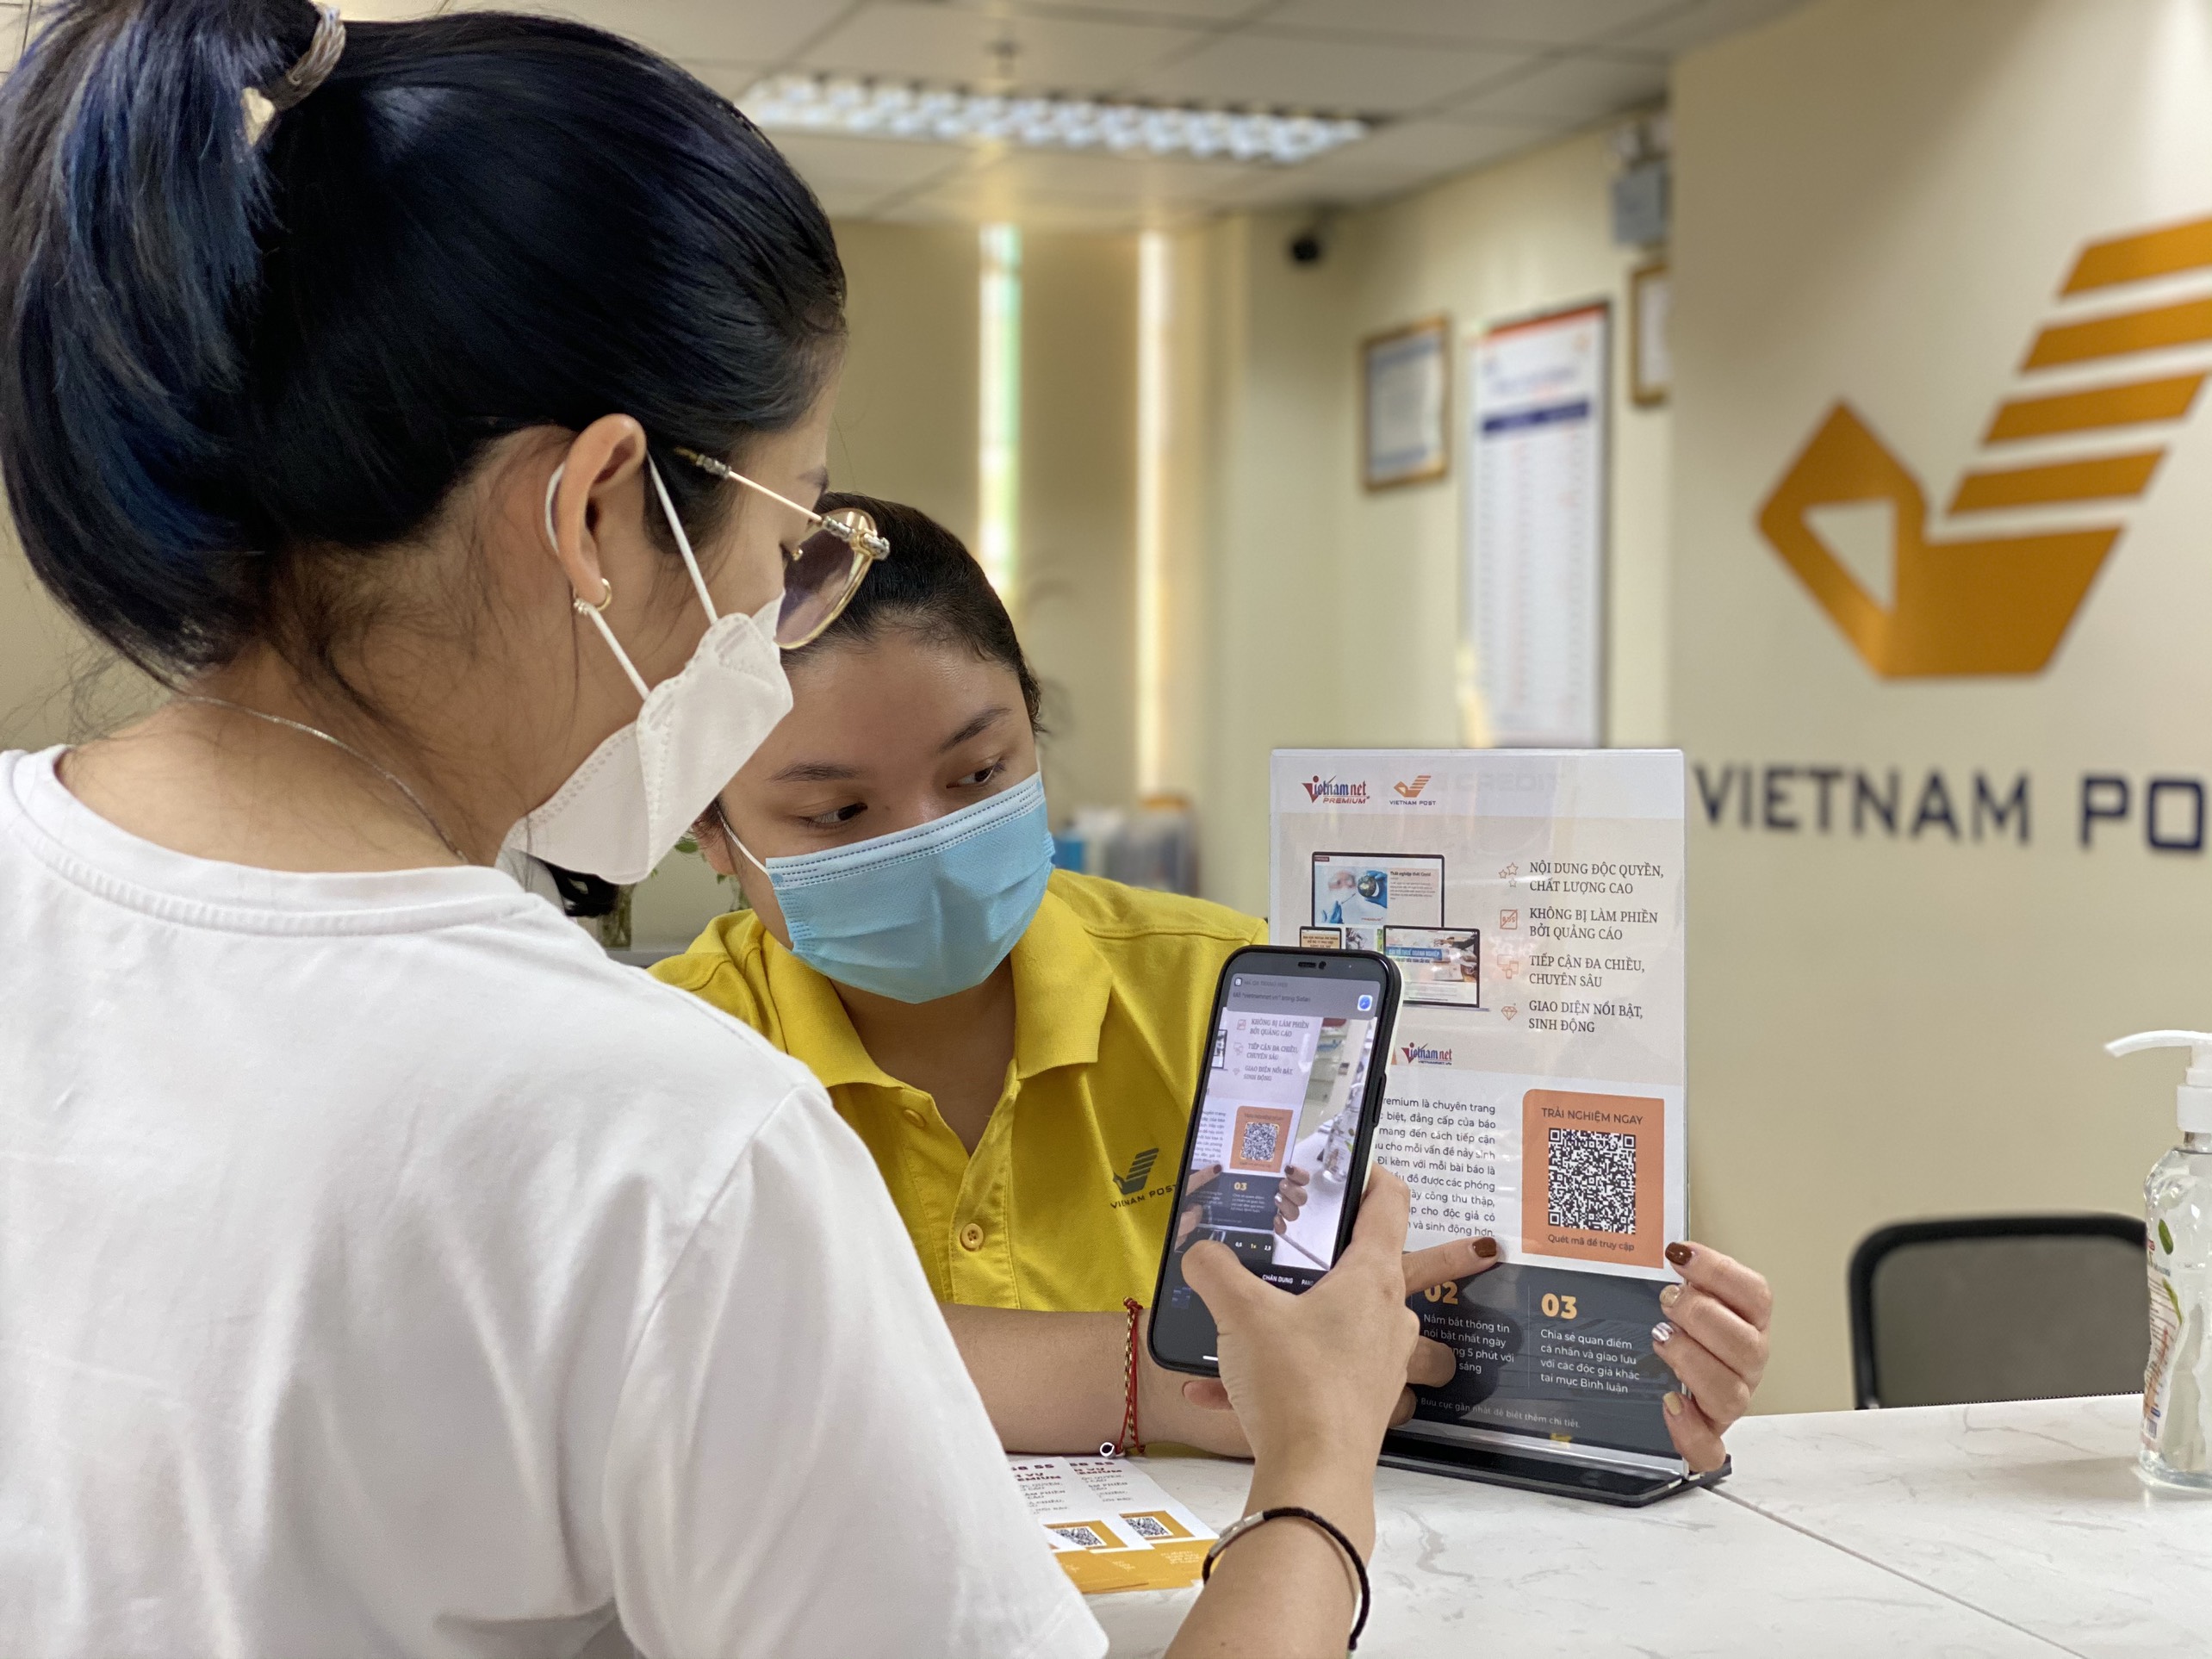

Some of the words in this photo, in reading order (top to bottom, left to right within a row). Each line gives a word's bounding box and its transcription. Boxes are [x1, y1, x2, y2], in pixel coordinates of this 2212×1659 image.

[1693, 763, 2031, 845] VIETNAM
[1530, 860, 1550, 875] NỘI
[1554, 862, 1588, 875] DUNG
[1592, 861, 1617, 876] ĐỘC
[1619, 862, 1664, 879] QUYỀN,
[1530, 878, 1560, 892] CHẤT
[1563, 880, 1606, 895] LƯỢNG
[1609, 882, 1633, 894] CAO
[1530, 906, 1572, 920] KHÔNG
[1575, 909, 1588, 923] BỊ
[1590, 910, 1617, 923] LÀM
[1620, 908, 1659, 923] PHIỀN
[1530, 923, 1550, 937] BỞI
[1553, 925, 1596, 941] QUẢNG
[1598, 927, 1623, 940] CÁO
[1529, 953, 1555, 967] TIẾP
[1557, 954, 1582, 970] CẬN
[1585, 957, 1601, 969] ĐA
[1605, 956, 1645, 973] CHIỀU,
[1529, 972, 1577, 986] CHUYÊN
[1579, 973, 1603, 987] SÂU
[1529, 1000, 1558, 1013] GIAO
[1561, 1000, 1590, 1014] DIỆN
[1593, 1001, 1615, 1016] NỔI
[1619, 1003, 1643, 1019] BẬT,
[1528, 1018, 1557, 1031] SINH
[1561, 1018, 1595, 1034] ĐỘNG
[1382, 1097, 1420, 1108] remium
[1421, 1098, 1430, 1109] là
[1432, 1101, 1467, 1112] chuyên
[1469, 1103, 1495, 1115] trang
[1541, 1106, 1564, 1118] TRẢI
[1567, 1109, 1611, 1124] NGHIỆM
[1614, 1114, 1643, 1125] NGAY
[1387, 1111, 1407, 1123] biệt,
[1409, 1112, 1433, 1126] đẳng
[1437, 1115, 1454, 1127] cấp
[1457, 1116, 1475, 1128] của
[1478, 1119, 1496, 1129] báo
[1379, 1128, 1406, 1139] mang
[1409, 1128, 1427, 1139] đến
[1431, 1131, 1452, 1140] cách
[1457, 1132, 1475, 1144] tiếp
[1478, 1135, 1495, 1146] cận
[1385, 1142, 1402, 1152] cho
[1405, 1143, 1422, 1153] mỗi
[1424, 1144, 1441, 1155] vấn
[1443, 1146, 1455, 1156] đề
[1476, 1150, 1495, 1160] sinh
[1377, 1155, 1388, 1165] Đi
[1390, 1157, 1410, 1167] kèm
[1413, 1159, 1426, 1169] với
[1429, 1159, 1447, 1171] mỗi
[1450, 1162, 1464, 1172] bài
[1467, 1164, 1484, 1174] báo
[1488, 1165, 1495, 1176] là
[1233, 1181, 1248, 1191] 03
[1407, 1173, 1419, 1184] đồ
[1420, 1175, 1445, 1186] được
[1445, 1177, 1462, 1188] các
[1464, 1180, 1495, 1193] phóng
[1425, 1192, 1448, 1203] công
[1451, 1194, 1468, 1203] thu
[1470, 1196, 1495, 1208] thập,
[1421, 1206, 1438, 1216] cho
[1443, 1209, 1461, 1220] độc
[1464, 1210, 1480, 1221] giả
[1484, 1213, 1495, 1222] có
[1414, 1221, 1424, 1230] và
[1426, 1222, 1445, 1232] sinh
[1447, 1224, 1472, 1237] động
[1475, 1227, 1495, 1238] hơn.
[1548, 1233, 1569, 1245] Quét
[1570, 1236, 1585, 1246] mã
[1587, 1237, 1599, 1247] để
[1600, 1240, 1617, 1251] truy
[1619, 1241, 1635, 1252] cập
[1278, 1276, 1294, 1284] DUNG
[1424, 1281, 1459, 1305] 02
[1541, 1292, 1578, 1320] 03
[1424, 1313, 1446, 1325] Nắm
[1448, 1315, 1463, 1327] bắt
[1465, 1319, 1494, 1333] thông
[1497, 1323, 1510, 1333] tin
[1440, 1329, 1457, 1341] bật
[1458, 1333, 1481, 1345] nhất
[1482, 1336, 1507, 1349] ngày
[1540, 1328, 1563, 1340] Chia
[1564, 1332, 1576, 1342] sẻ
[1578, 1334, 1604, 1346] quan
[1606, 1336, 1632, 1350] điểm
[1467, 1348, 1474, 1357] 5
[1476, 1349, 1499, 1360] phút
[1500, 1352, 1515, 1363] với
[1540, 1344, 1552, 1353] cá
[1554, 1345, 1581, 1358] nhân
[1582, 1349, 1594, 1359] và
[1595, 1351, 1619, 1363] giao
[1620, 1354, 1637, 1365] lưu
[1458, 1362, 1482, 1374] sáng
[1540, 1358, 1556, 1369] với
[1557, 1360, 1575, 1371] các
[1576, 1363, 1595, 1376] độc
[1597, 1365, 1613, 1377] giả
[1615, 1368, 1641, 1381] khác
[1540, 1373, 1553, 1384] tại
[1556, 1376, 1578, 1388] mục
[1581, 1377, 1604, 1390] Bình
[1606, 1382, 1629, 1395] luận
[1421, 1397, 1437, 1407] Bưu
[1438, 1401, 1454, 1411] cục
[1455, 1401, 1470, 1413] gần
[1472, 1405, 1491, 1415] nhất
[1493, 1406, 1504, 1417] để
[1506, 1409, 1523, 1420] biết
[1525, 1412, 1548, 1424] thêm
[1549, 1415, 1563, 1426] chi
